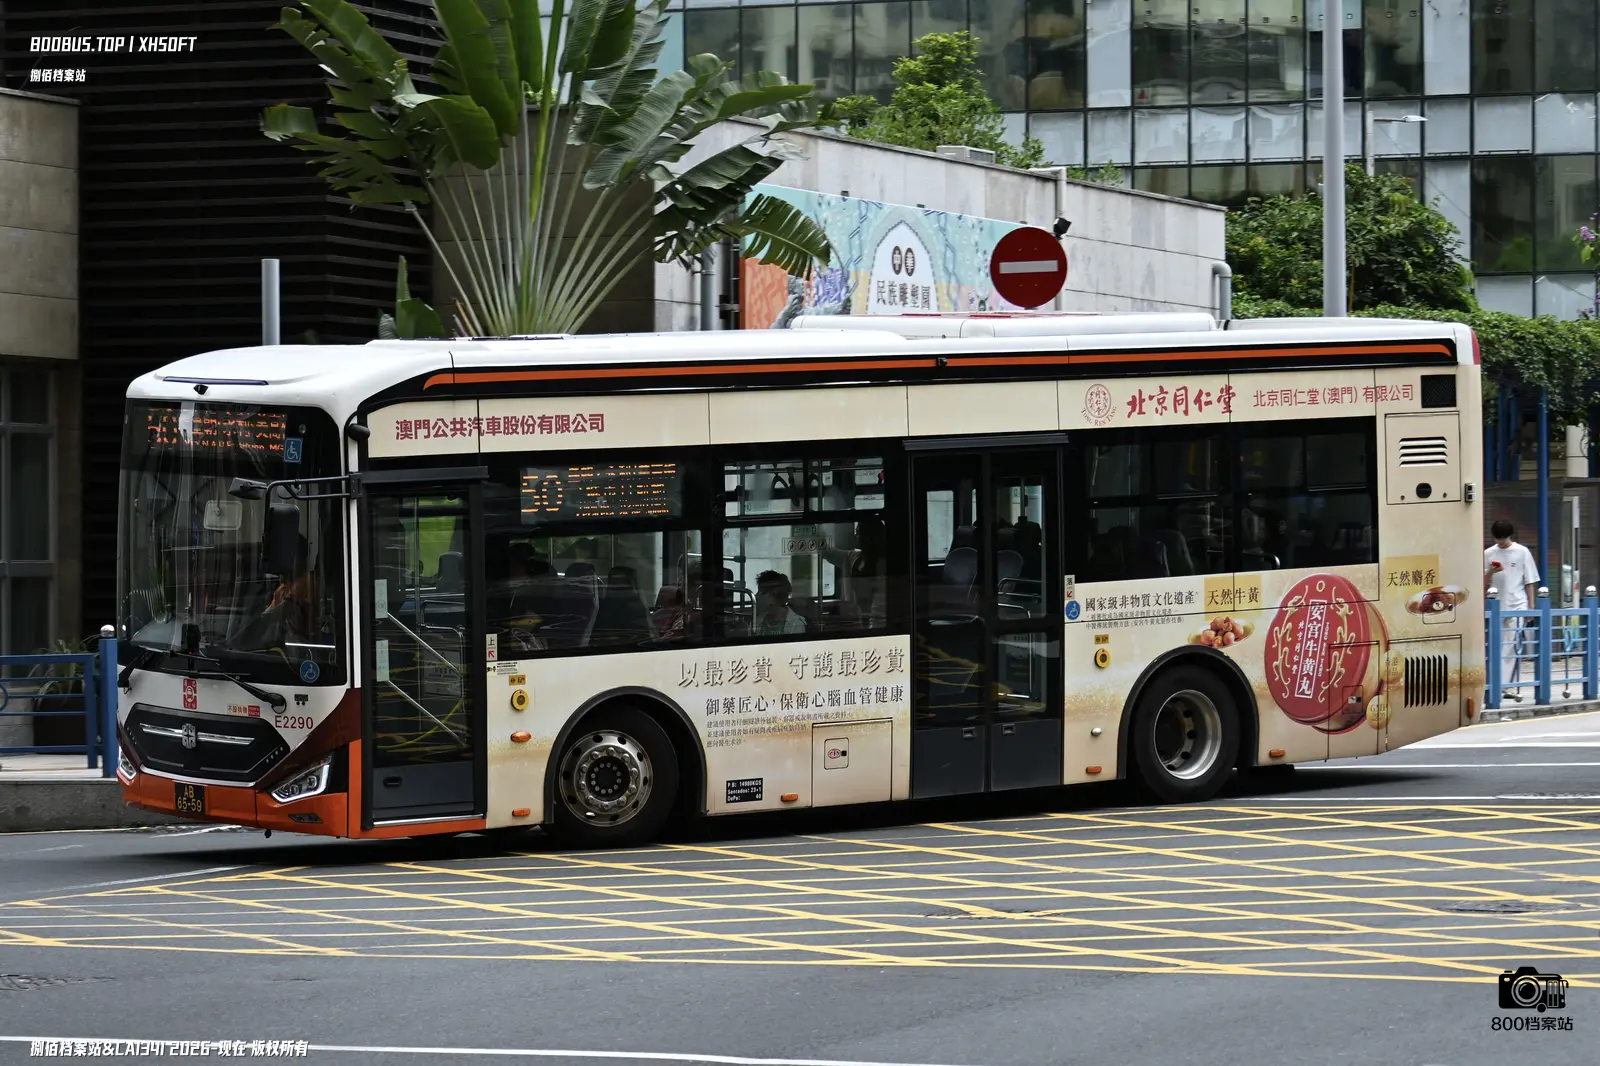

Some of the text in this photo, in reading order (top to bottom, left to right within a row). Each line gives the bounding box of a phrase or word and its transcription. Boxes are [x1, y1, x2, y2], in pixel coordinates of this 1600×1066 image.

[1126, 384, 1238, 419] 北京同仁堂
[395, 412, 605, 441] 澳門公共汽車股份有限公司
[1386, 568, 1436, 588] 天然麝香
[677, 646, 905, 689] 以最珍貴 守護最珍貴
[274, 715, 314, 730] E2290
[183, 785, 195, 799] AB
[177, 797, 202, 812] 65-59
